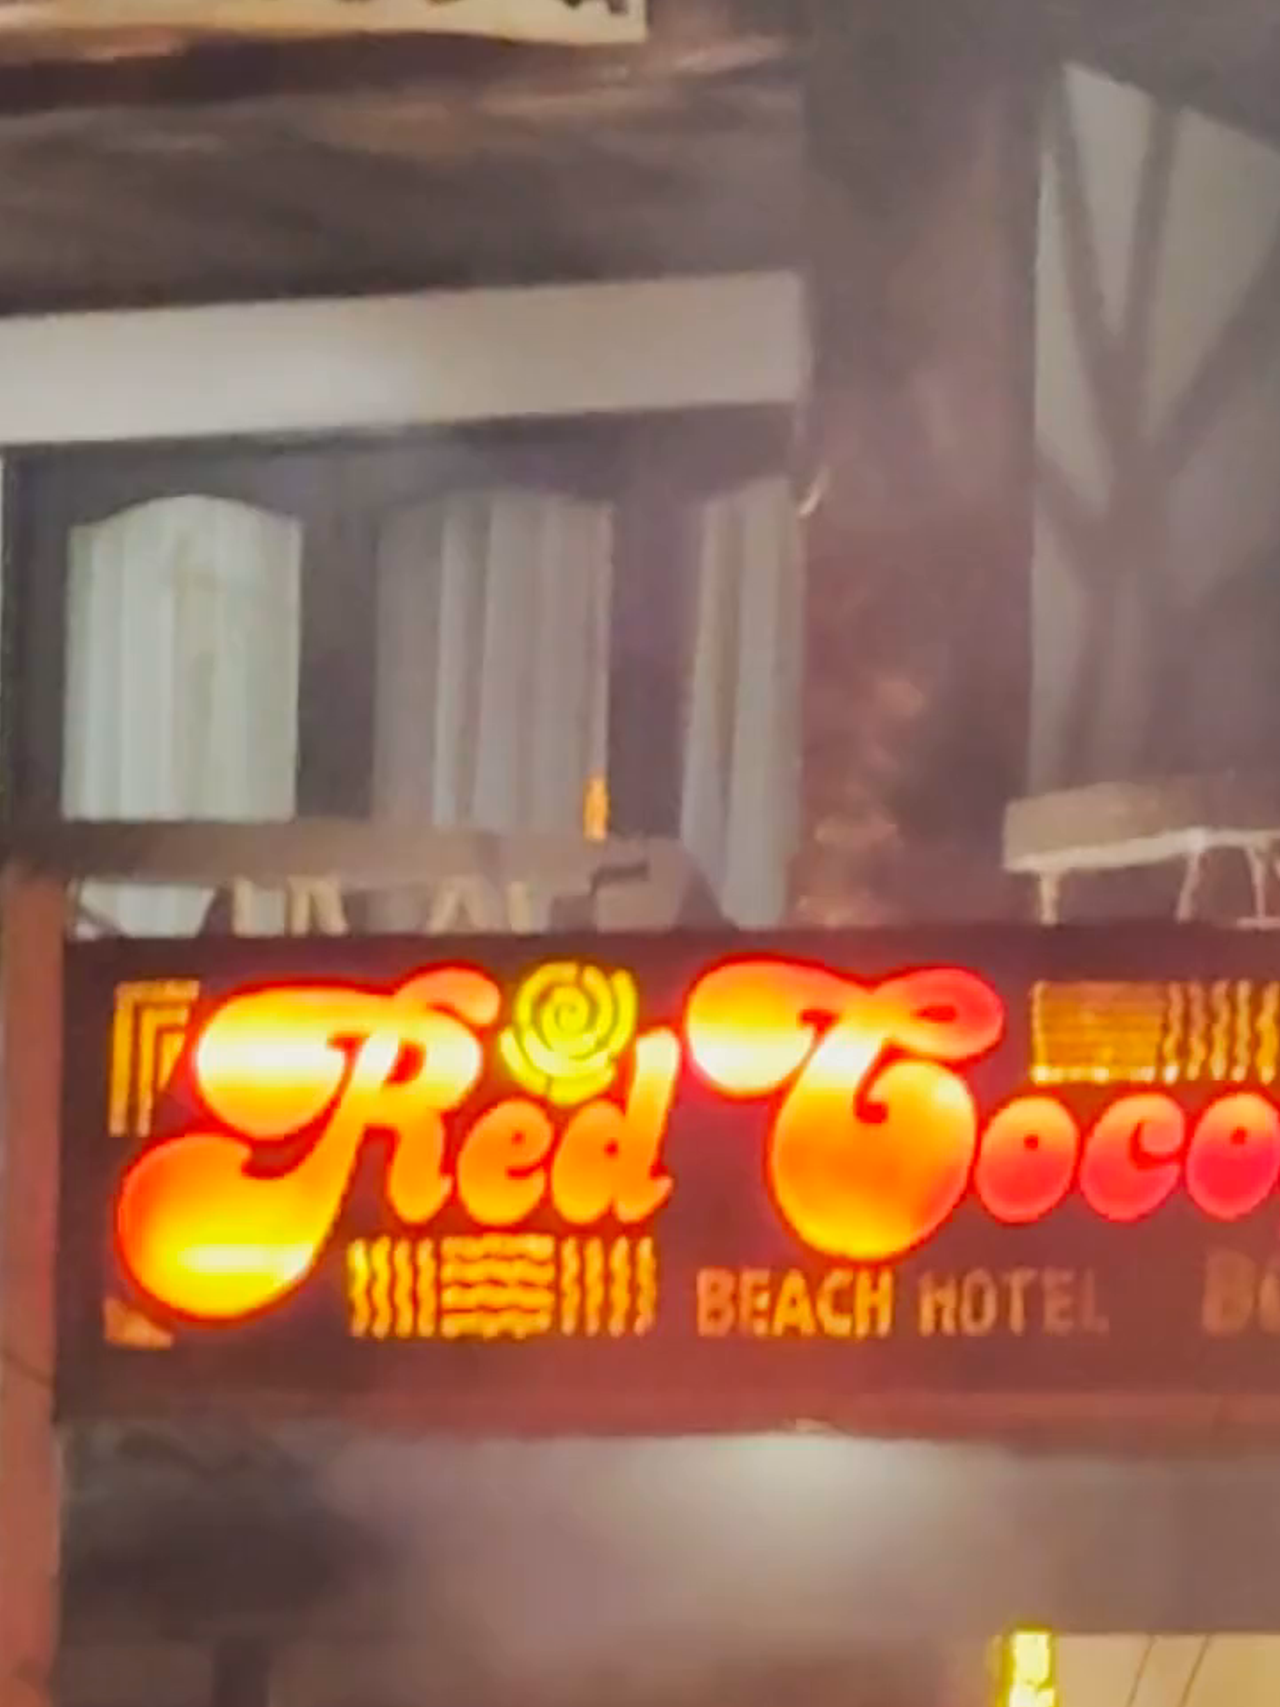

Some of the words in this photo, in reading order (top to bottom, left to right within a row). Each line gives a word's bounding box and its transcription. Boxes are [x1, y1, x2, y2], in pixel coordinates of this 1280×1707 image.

[117, 964, 679, 1318] Red
[696, 1265, 893, 1339] BEACH
[918, 1267, 1111, 1337] HOTEL
